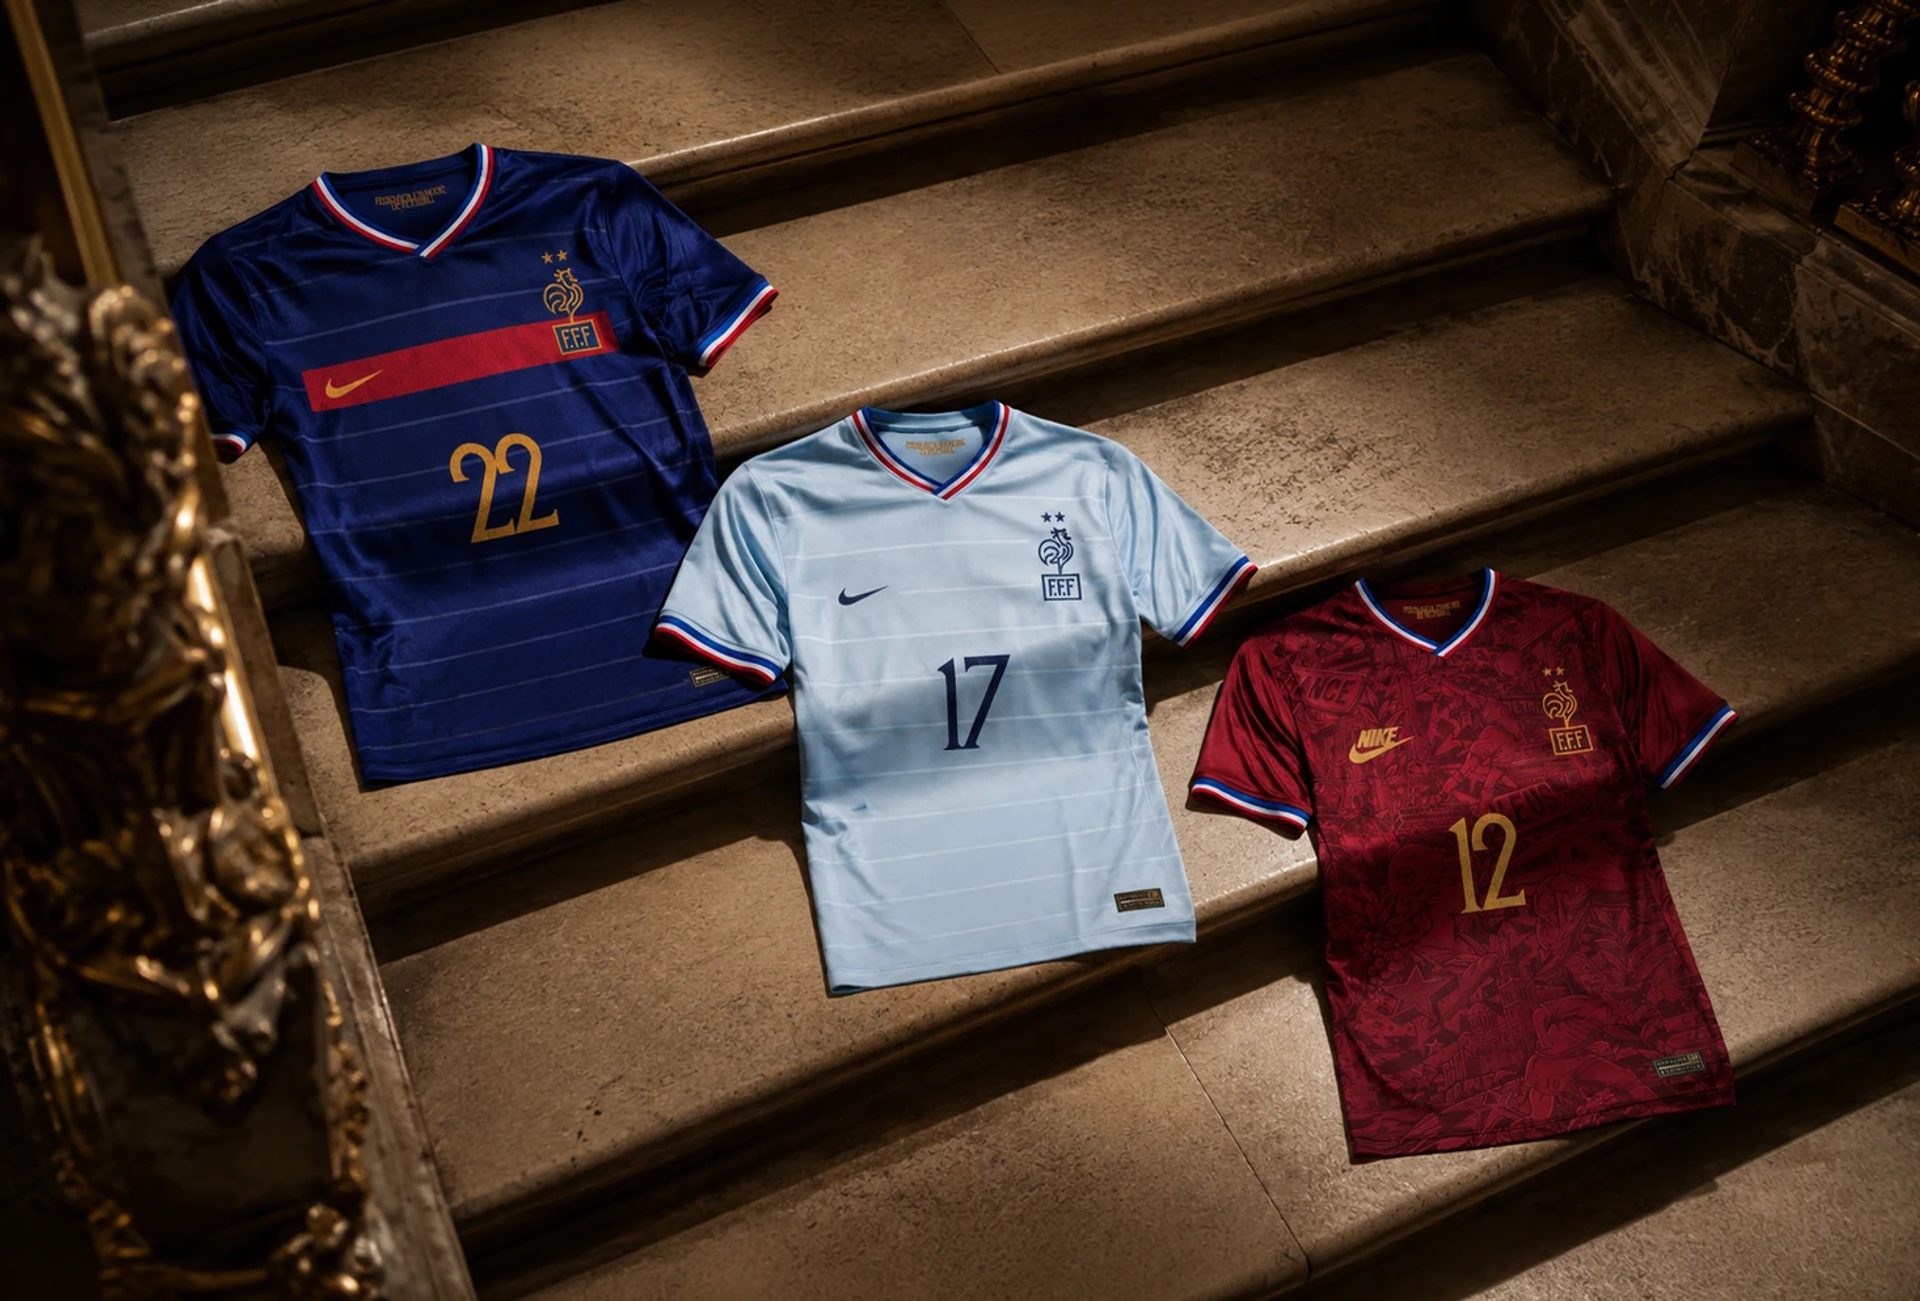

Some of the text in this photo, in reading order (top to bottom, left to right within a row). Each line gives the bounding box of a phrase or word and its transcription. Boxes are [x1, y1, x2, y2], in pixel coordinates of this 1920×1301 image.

[449, 432, 560, 544] 22
[937, 654, 1010, 751] 17
[1356, 726, 1400, 750] NIKE
[1448, 812, 1527, 914] 12
